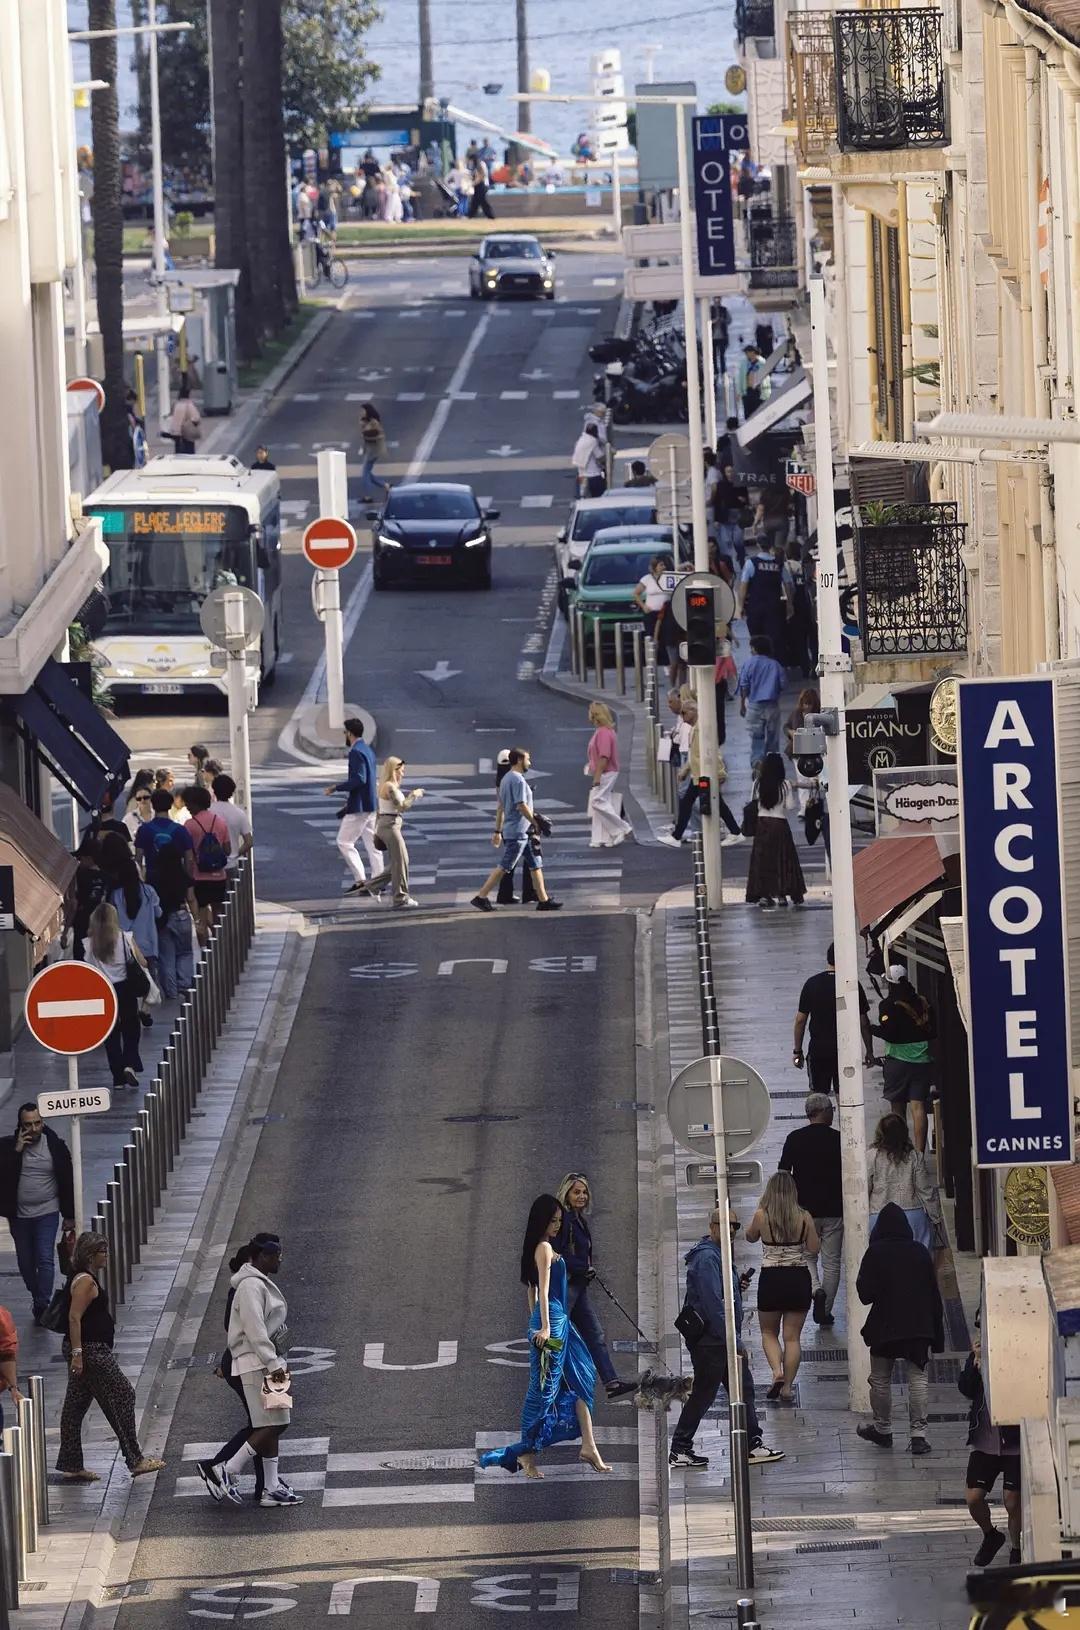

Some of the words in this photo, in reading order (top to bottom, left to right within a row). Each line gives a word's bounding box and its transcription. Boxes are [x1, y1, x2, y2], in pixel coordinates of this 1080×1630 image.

[696, 118, 726, 267] HOTEL
[787, 475, 816, 494] HEU
[934, 738, 957, 753] NOTA
[895, 795, 958, 810] Häagen-Daz
[983, 699, 1042, 1120] ARCOTEL
[47, 1097, 77, 1111] SAUF
[79, 1095, 102, 1108] BUS
[986, 1135, 1063, 1152] CANNES
[1012, 1229, 1050, 1244] NOTAIRE
[187, 1572, 580, 1620] BUS
